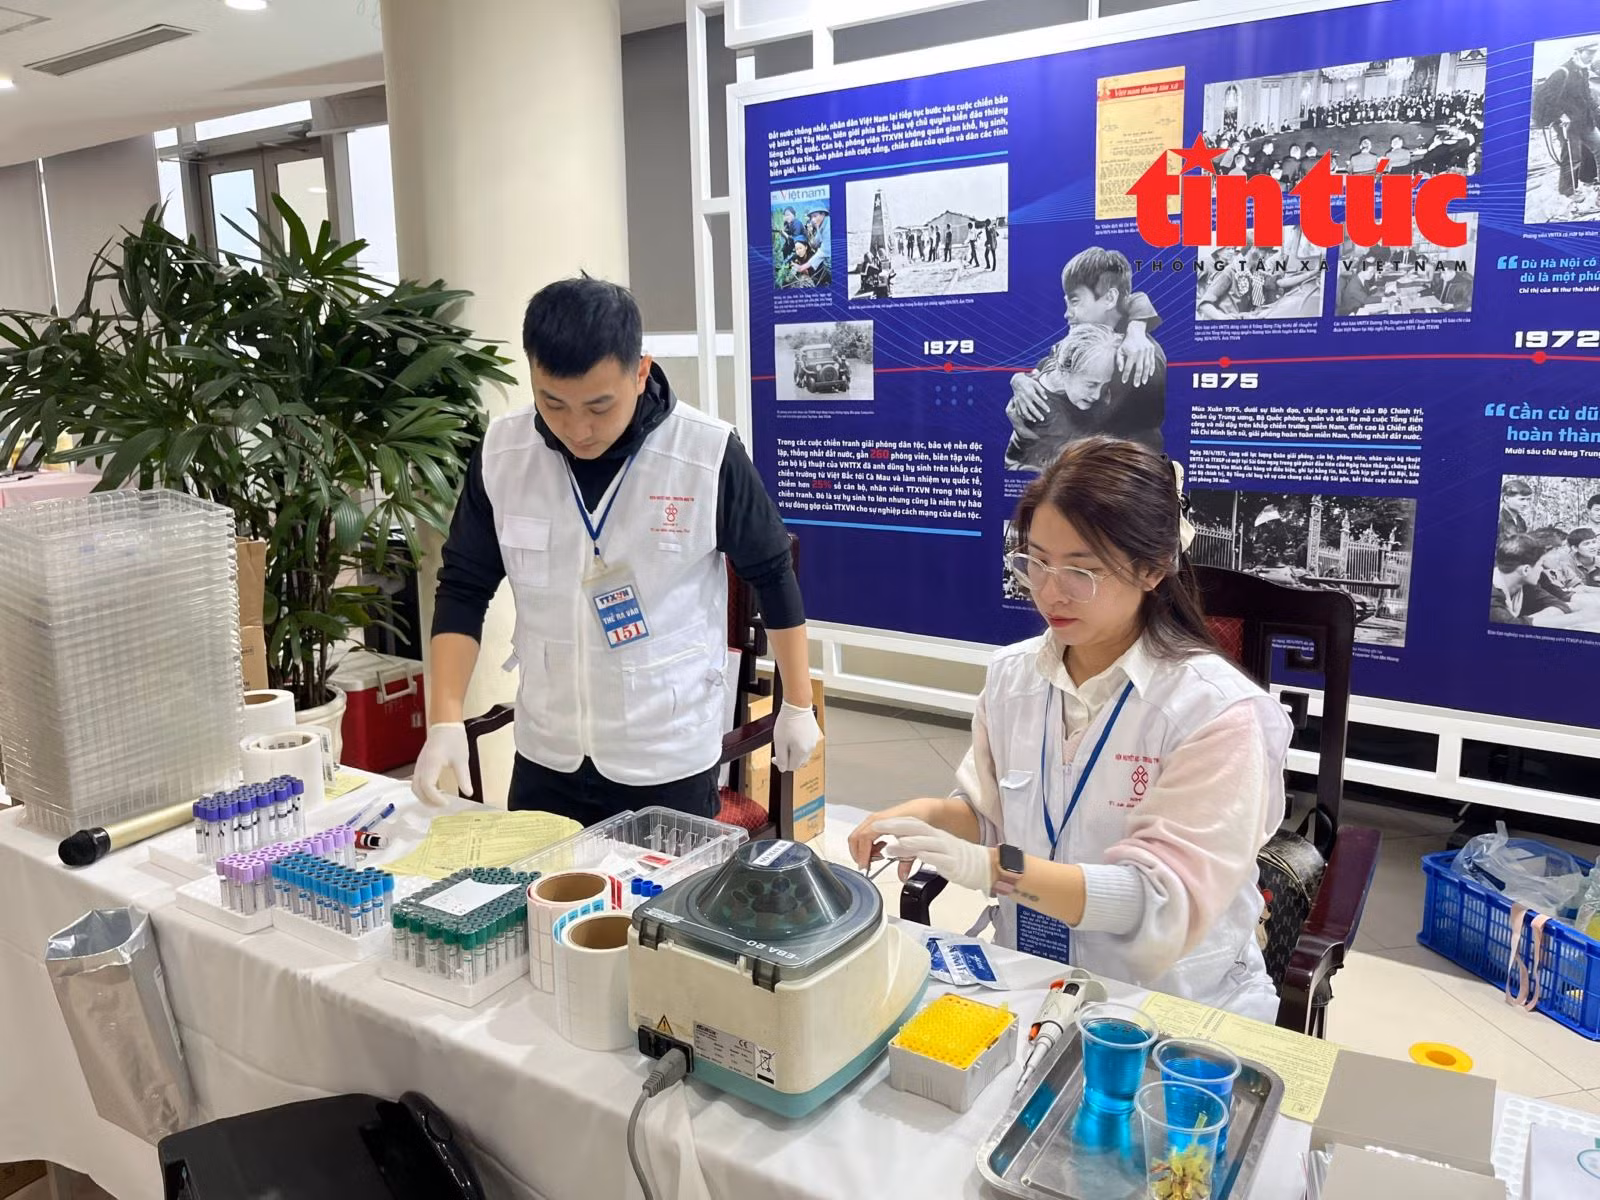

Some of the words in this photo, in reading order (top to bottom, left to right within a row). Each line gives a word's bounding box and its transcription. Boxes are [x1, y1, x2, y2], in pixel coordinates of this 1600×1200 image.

[1540, 258, 1556, 268] Hà
[1560, 258, 1580, 269] Nội
[1583, 257, 1596, 266] có
[1520, 272, 1535, 282] dù
[1539, 272, 1548, 282] là
[1552, 272, 1576, 283] một
[1515, 330, 1600, 348] 1972
[924, 340, 974, 355] 1979
[1192, 373, 1259, 388] 1975
[1509, 402, 1542, 420] Cần
[1548, 406, 1569, 420] cù
[1507, 426, 1552, 441] hoàn
[778, 438, 795, 447] Trong
[808, 439, 822, 448] cuộc
[824, 438, 840, 446] chiến
[862, 440, 874, 449] giải
[876, 440, 897, 449] phóng
[913, 441, 926, 450] tộc,
[943, 441, 952, 450] vệ
[954, 440, 968, 449] nền
[970, 442, 982, 451] độc
[778, 448, 789, 458] lập,
[790, 447, 808, 458] thống
[810, 448, 824, 457] nhất
[825, 448, 836, 457] đất
[838, 450, 854, 460] nước,
[856, 449, 869, 460] gần
[870, 450, 889, 459] 260
[891, 452, 912, 461] phóng
[914, 452, 931, 462] viên,
[950, 453, 962, 462] tập
[964, 454, 982, 463] viên,
[1558, 449, 1578, 457] vàng
[790, 459, 798, 469] bộ
[799, 460, 807, 469] kỹ
[808, 460, 825, 469] thuật
[887, 463, 904, 472] dũng
[906, 463, 915, 472] hy
[950, 463, 968, 474] khắp
[778, 468, 794, 477] chiến
[796, 470, 816, 480] trường
[827, 471, 840, 480] Việt
[842, 470, 853, 479] Bắc
[918, 475, 939, 484] nhiệm
[952, 474, 970, 485] quốc
[972, 475, 982, 486] tế,
[778, 478, 796, 487] chiếm
[834, 480, 841, 489] số
[857, 483, 867, 492] bộ,
[933, 486, 952, 496] trong
[972, 488, 982, 497] kỳ
[614, 622, 640, 642] 151
[746, 940, 767, 950] 20
[769, 946, 797, 959] EBA
